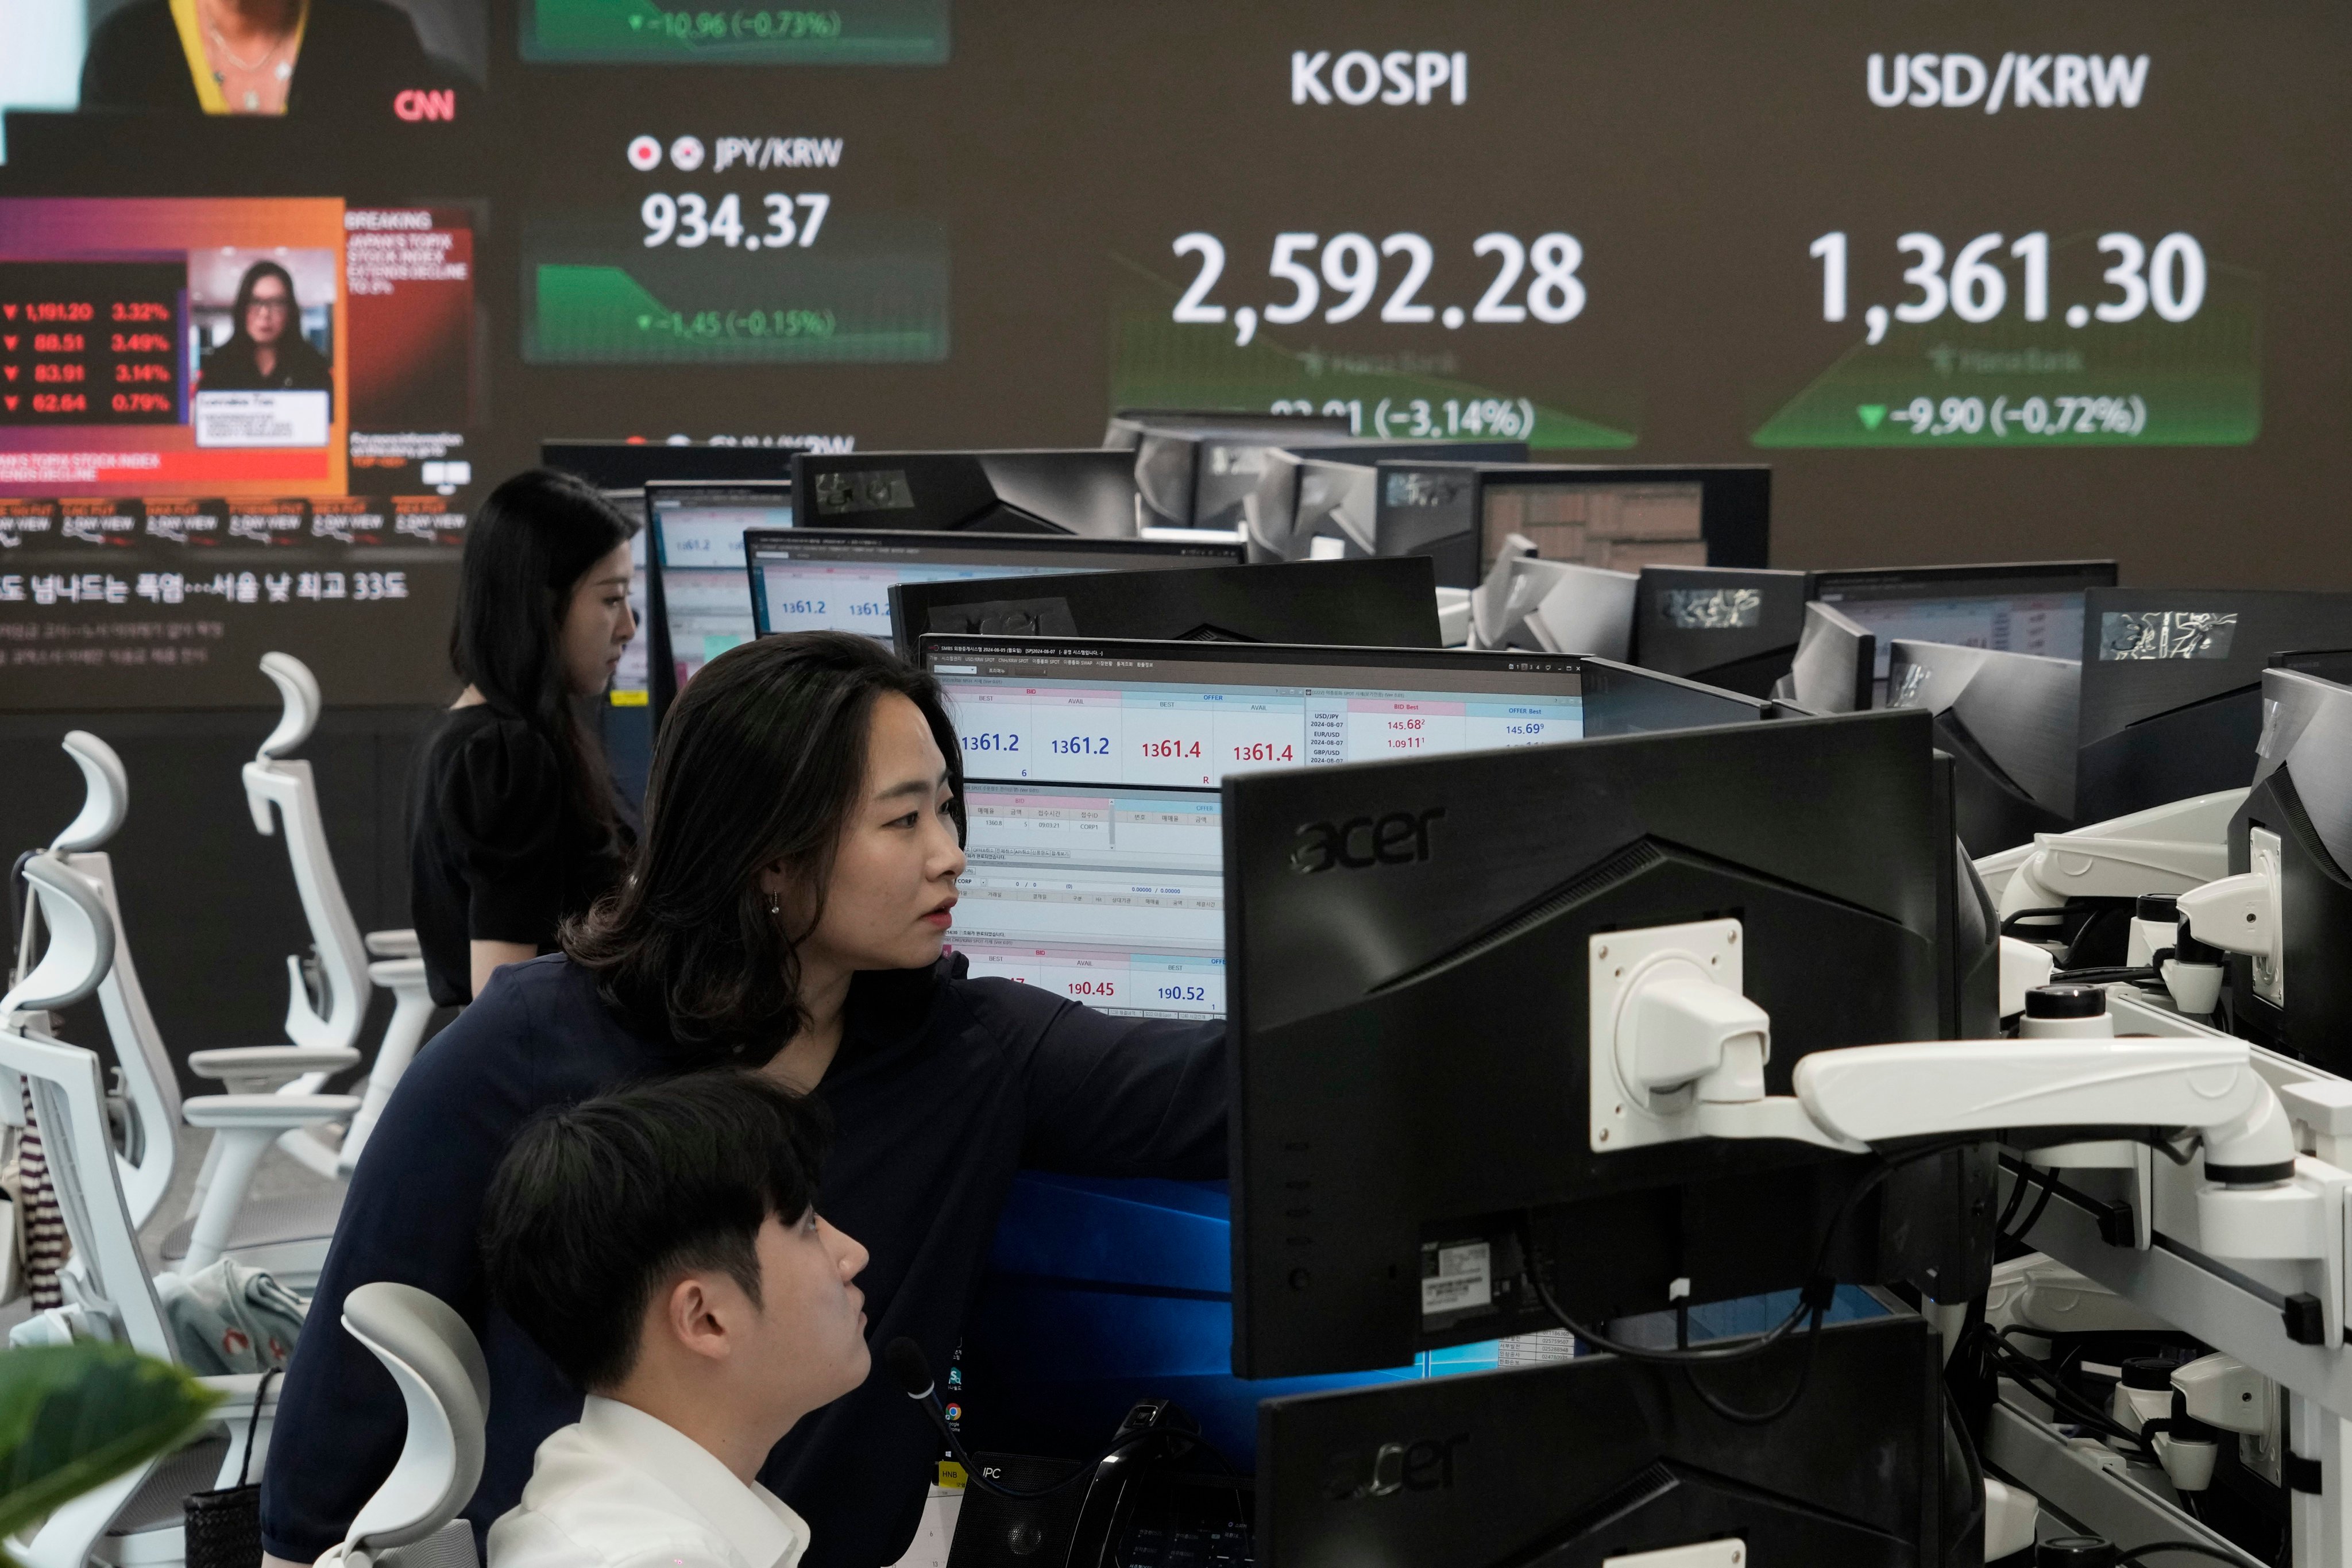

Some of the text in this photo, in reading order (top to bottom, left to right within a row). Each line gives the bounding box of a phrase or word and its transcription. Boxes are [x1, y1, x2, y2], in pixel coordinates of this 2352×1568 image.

[1291, 50, 1467, 106] KOSPI
[1867, 52, 2149, 115] USD/KRW
[394, 90, 455, 121] CNN
[713, 137, 844, 173] JPY/KRW
[641, 193, 831, 251] 934.37
[1172, 231, 1586, 347] 2,592.28
[1809, 231, 2207, 345] 1,361.30
[1374, 397, 1534, 441] (-3.14%)
[1890, 395, 2146, 438] -9.90 (-0.72%)
[0, 574, 26, 601] 도
[31, 573, 130, 604] 넘나드는
[353, 572, 410, 600] 33도
[782, 600, 826, 615] 1361.2
[962, 733, 1019, 751] 1361.2
[1052, 736, 1109, 755] 1361.2
[1142, 740, 1201, 758] 1361.4
[1234, 743, 1293, 762] 1361.4
[1290, 807, 1446, 874] acer
[1068, 981, 1114, 996] 190.45
[1157, 986, 1204, 1001] 190.52
[983, 1467, 1001, 1478] IPC
